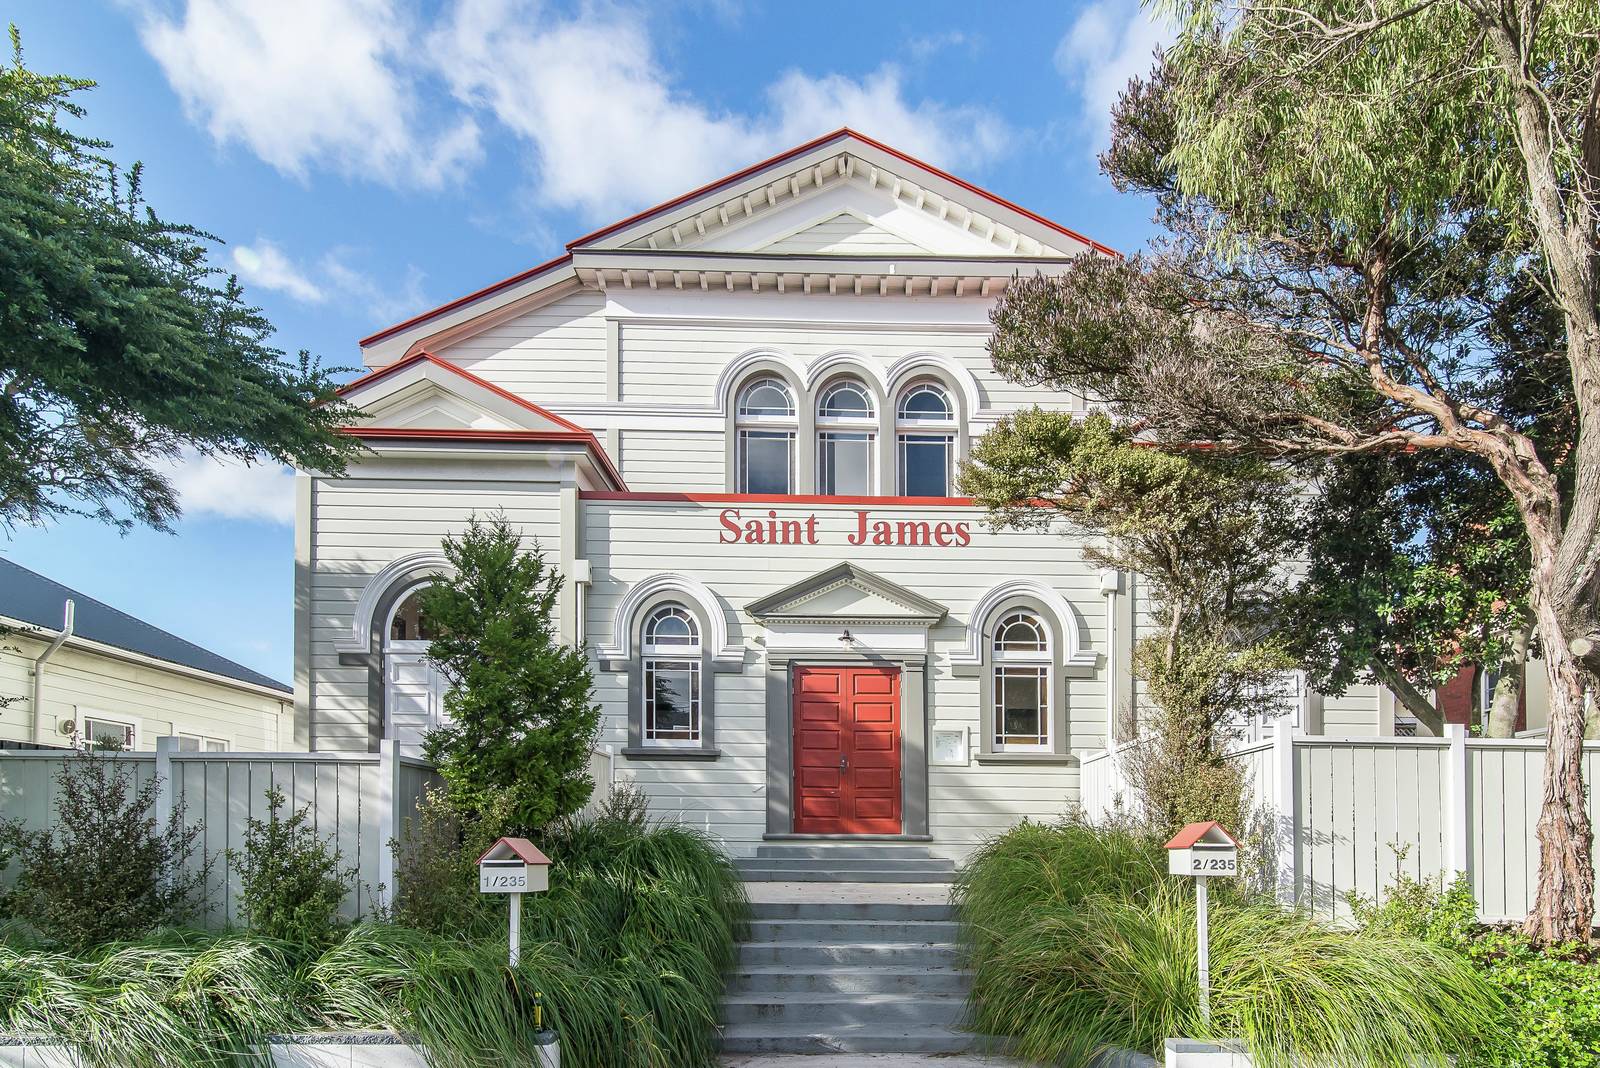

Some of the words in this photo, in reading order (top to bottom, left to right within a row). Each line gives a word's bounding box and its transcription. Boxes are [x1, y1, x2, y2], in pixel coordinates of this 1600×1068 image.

[719, 508, 819, 545] Saint
[847, 511, 971, 547] James
[1192, 858, 1236, 871] 2/235
[483, 876, 526, 888] 1/235
